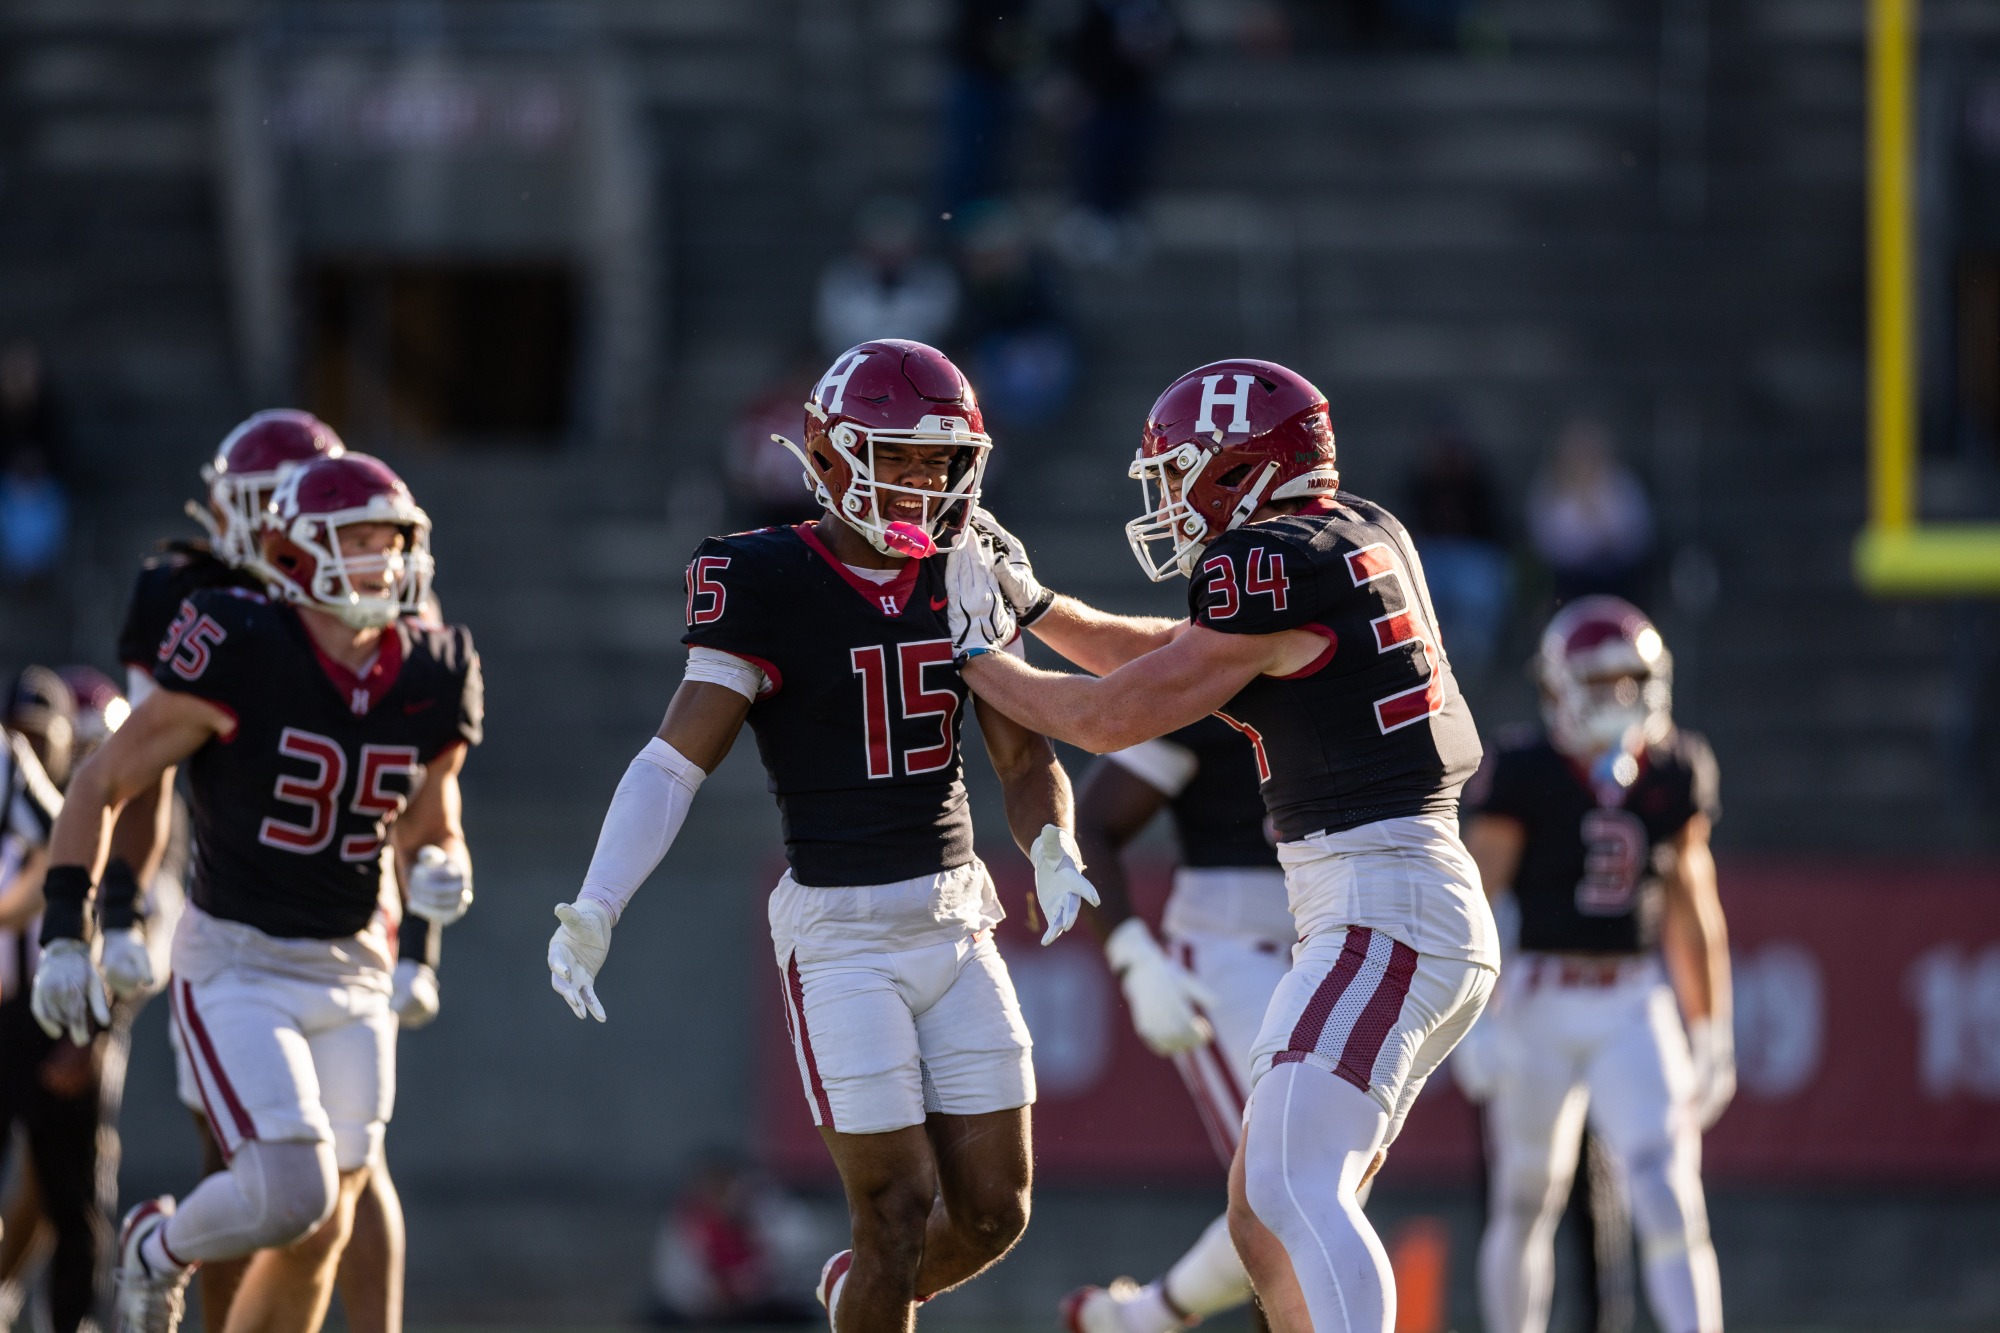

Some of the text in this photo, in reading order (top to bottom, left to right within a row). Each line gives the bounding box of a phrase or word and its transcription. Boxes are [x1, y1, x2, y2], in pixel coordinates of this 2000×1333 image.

[814, 350, 870, 414] H
[1195, 374, 1255, 433] H
[685, 556, 732, 627] 15
[879, 596, 900, 615] H
[1203, 546, 1290, 620] 34
[157, 600, 228, 681] 35
[850, 638, 959, 780] 15
[258, 726, 420, 862] 35
[1574, 808, 1649, 918] 3
